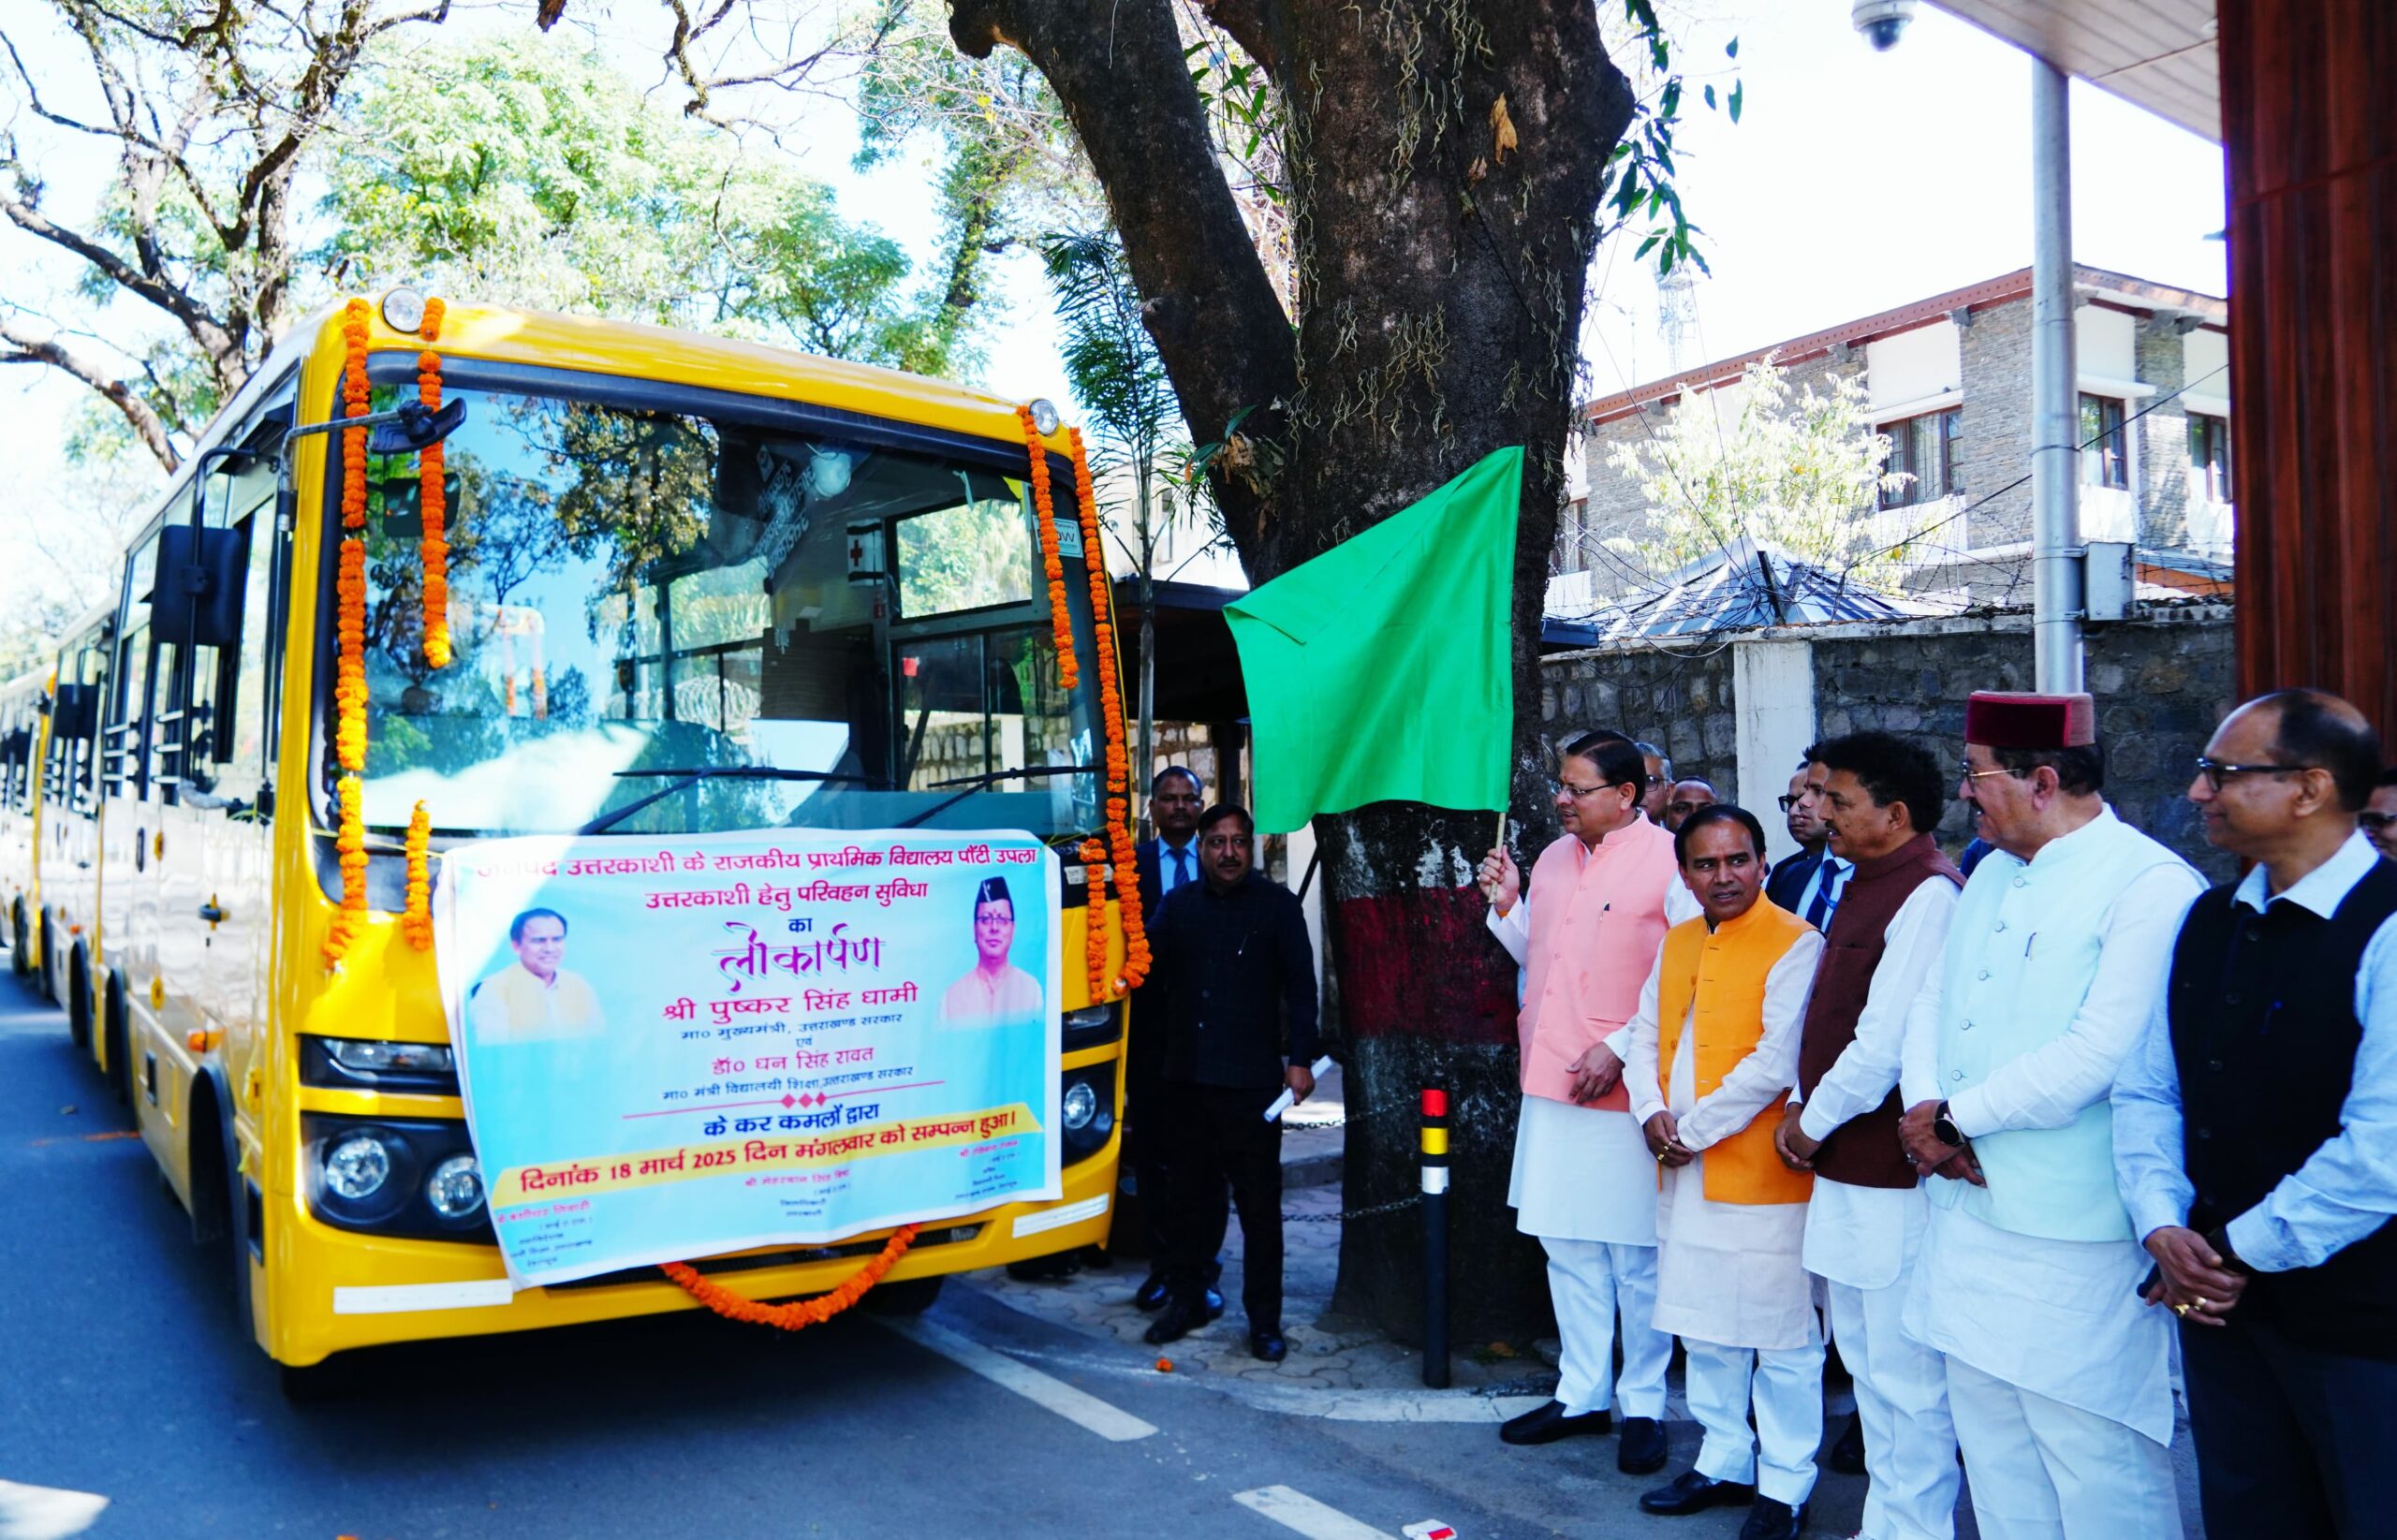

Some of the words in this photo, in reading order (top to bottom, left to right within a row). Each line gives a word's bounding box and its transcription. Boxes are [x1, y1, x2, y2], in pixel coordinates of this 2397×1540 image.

[566, 851, 674, 876] उत्तरकाशी
[683, 851, 706, 871] के
[713, 848, 801, 871] राजकीय
[807, 845, 884, 870] प्राथमिक
[889, 844, 953, 867] विद्यालय
[994, 848, 1037, 864] उपला
[645, 882, 751, 909] उत्तरकाशी
[757, 882, 792, 911] हेतु
[798, 879, 870, 902] परिवहन
[875, 877, 929, 907] सुविधा
[787, 917, 813, 932] का
[712, 921, 886, 994] लोकार्पण
[662, 996, 697, 1020] श्री
[709, 995, 793, 1024] पुष्कर
[803, 988, 852, 1012] सिंह
[860, 1013, 903, 1026] सरकार
[796, 1049, 830, 1070] सिंह
[835, 1045, 875, 1065] रावत
[694, 1081, 721, 1098] मंत्री
[877, 1065, 914, 1079] सरकार
[704, 1115, 728, 1137] के
[735, 1115, 773, 1134] कर
[779, 1104, 843, 1129] कमलों
[846, 1102, 881, 1126] द्वारा
[521, 1163, 600, 1194] दिनांक
[610, 1164, 632, 1181] 18
[639, 1149, 685, 1175] मार्च
[693, 1149, 736, 1169] 2025
[744, 1139, 788, 1163] दिन
[795, 1132, 875, 1159] मंगलवार
[880, 1124, 905, 1144] को
[911, 1119, 975, 1141] सम्पन्न
